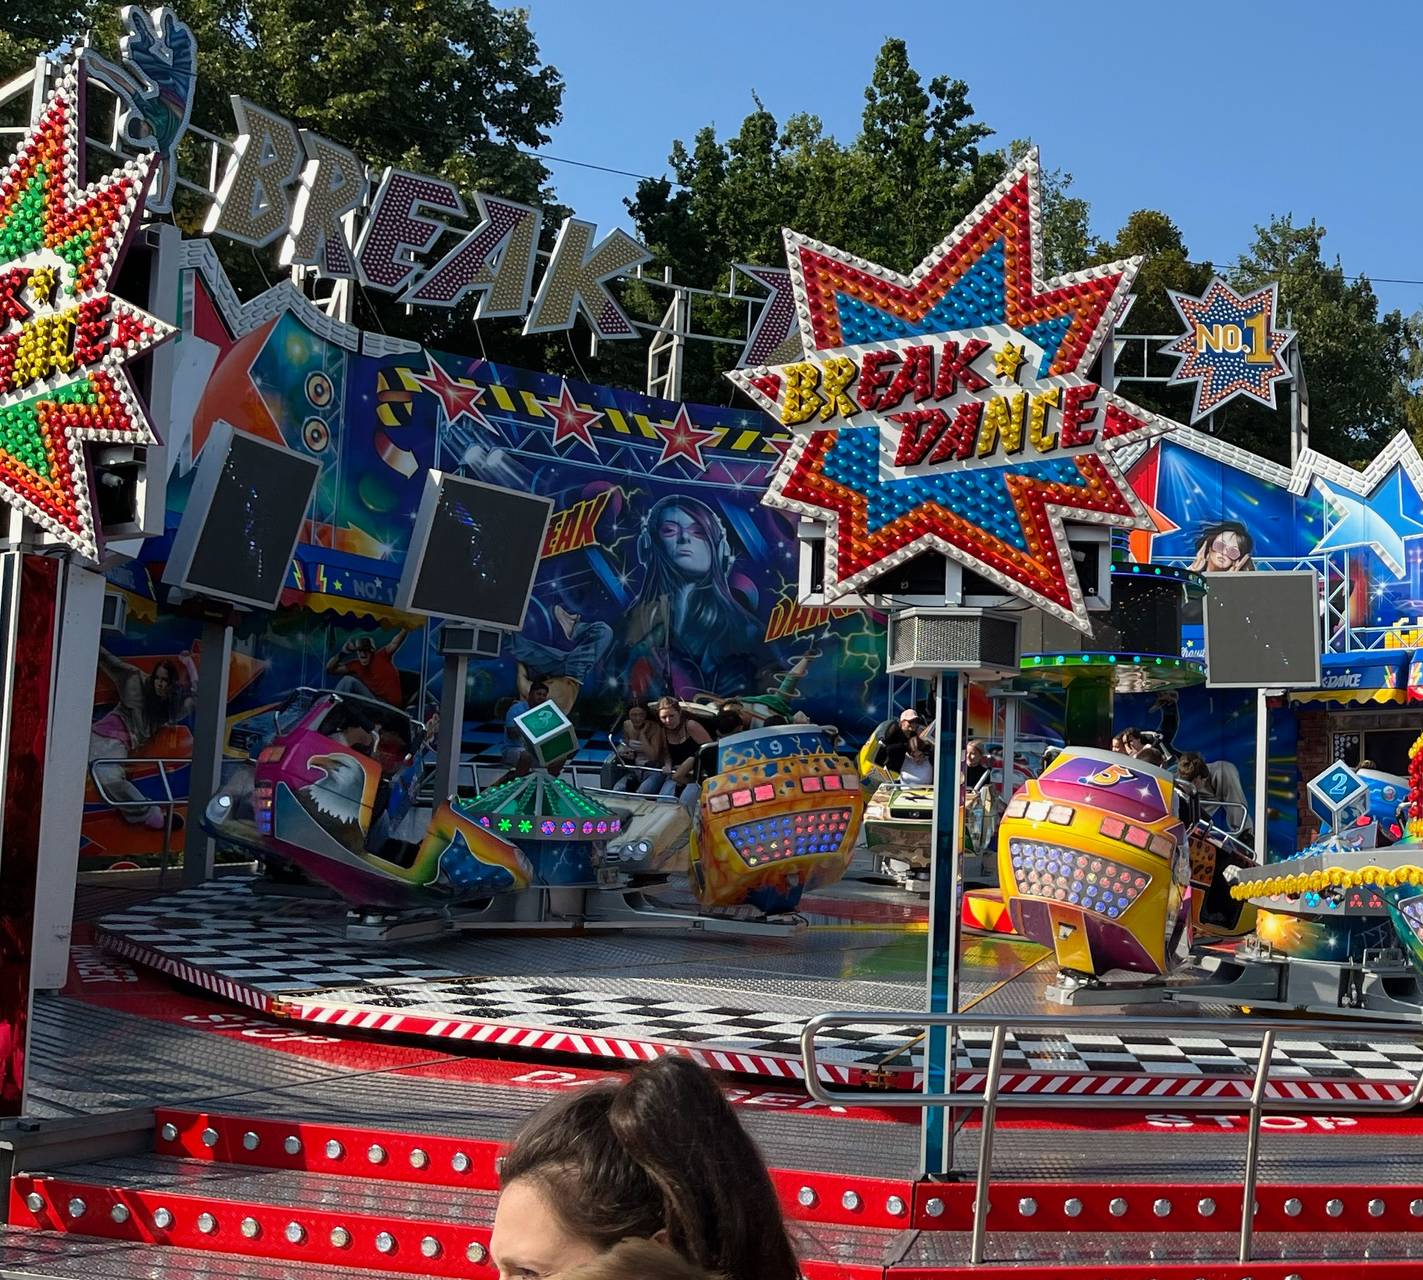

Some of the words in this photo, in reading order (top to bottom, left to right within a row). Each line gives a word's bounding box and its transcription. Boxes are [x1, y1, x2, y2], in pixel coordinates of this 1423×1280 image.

[202, 95, 655, 340] BREAK
[782, 338, 993, 425] BREAK
[886, 382, 1100, 467] DANCE
[540, 490, 612, 560] EAK
[769, 739, 783, 755] 9
[1091, 763, 1134, 787] 5
[1329, 772, 1348, 795] 2
[1144, 1113, 1358, 1131] STOP
